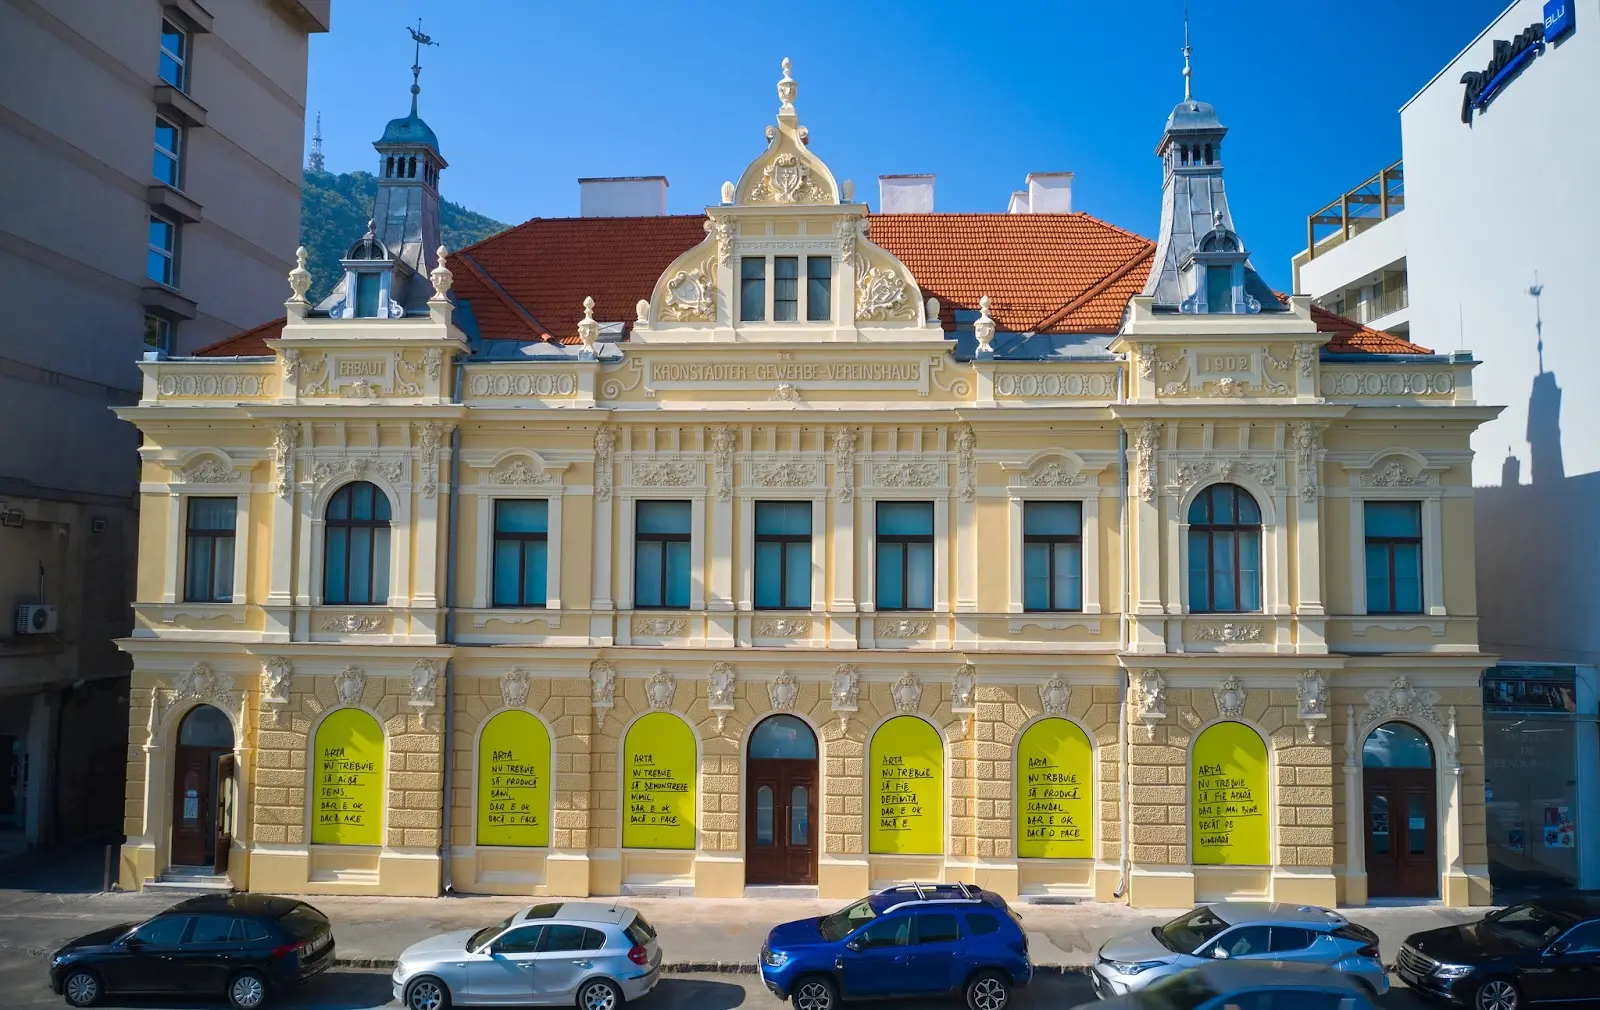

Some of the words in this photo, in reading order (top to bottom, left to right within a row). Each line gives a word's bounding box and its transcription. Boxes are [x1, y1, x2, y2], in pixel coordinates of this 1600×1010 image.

[1545, 5, 1565, 29] BLU
[340, 361, 384, 375] ERBAUT
[1206, 356, 1249, 372] 1902
[324, 748, 344, 758] ARTA
[492, 750, 512, 760] ARTA
[634, 754, 652, 763] ARTA
[882, 756, 902, 765] ARTA
[1028, 757, 1047, 767] ARTA
[324, 762, 334, 770] NU
[338, 760, 374, 770] TREBUIE
[506, 764, 534, 774] TREBUIE
[1199, 764, 1222, 775] ARTA
[644, 768, 672, 777] TREBUIE
[882, 768, 893, 776] NU
[897, 768, 931, 778] TREBUIE
[1028, 774, 1039, 783] NU
[1042, 772, 1076, 782] TREBUIE
[324, 774, 332, 783] SĂ
[506, 777, 538, 786] PRODUCĂ
[645, 782, 688, 791] DEMONSTREZE
[896, 781, 909, 792] FIE
[1198, 780, 1210, 790] NU
[1215, 778, 1245, 788] TREBUIE
[1028, 788, 1038, 798] SĂ
[1044, 788, 1079, 798] PRODUCĂ
[1215, 791, 1226, 800] FIE
[631, 804, 644, 812] DAR
[882, 808, 894, 816] DAR
[1199, 806, 1212, 816] DAR
[1217, 807, 1221, 816] E
[1226, 804, 1238, 814] MAI
[1242, 805, 1258, 814] BINE
[661, 816, 677, 824] FACE
[902, 819, 908, 828] E
[1028, 816, 1044, 824] DAR
[1050, 816, 1054, 824] E
[1061, 816, 1074, 824] OK
[1225, 820, 1234, 828] PE
[1060, 829, 1080, 838] FACE
